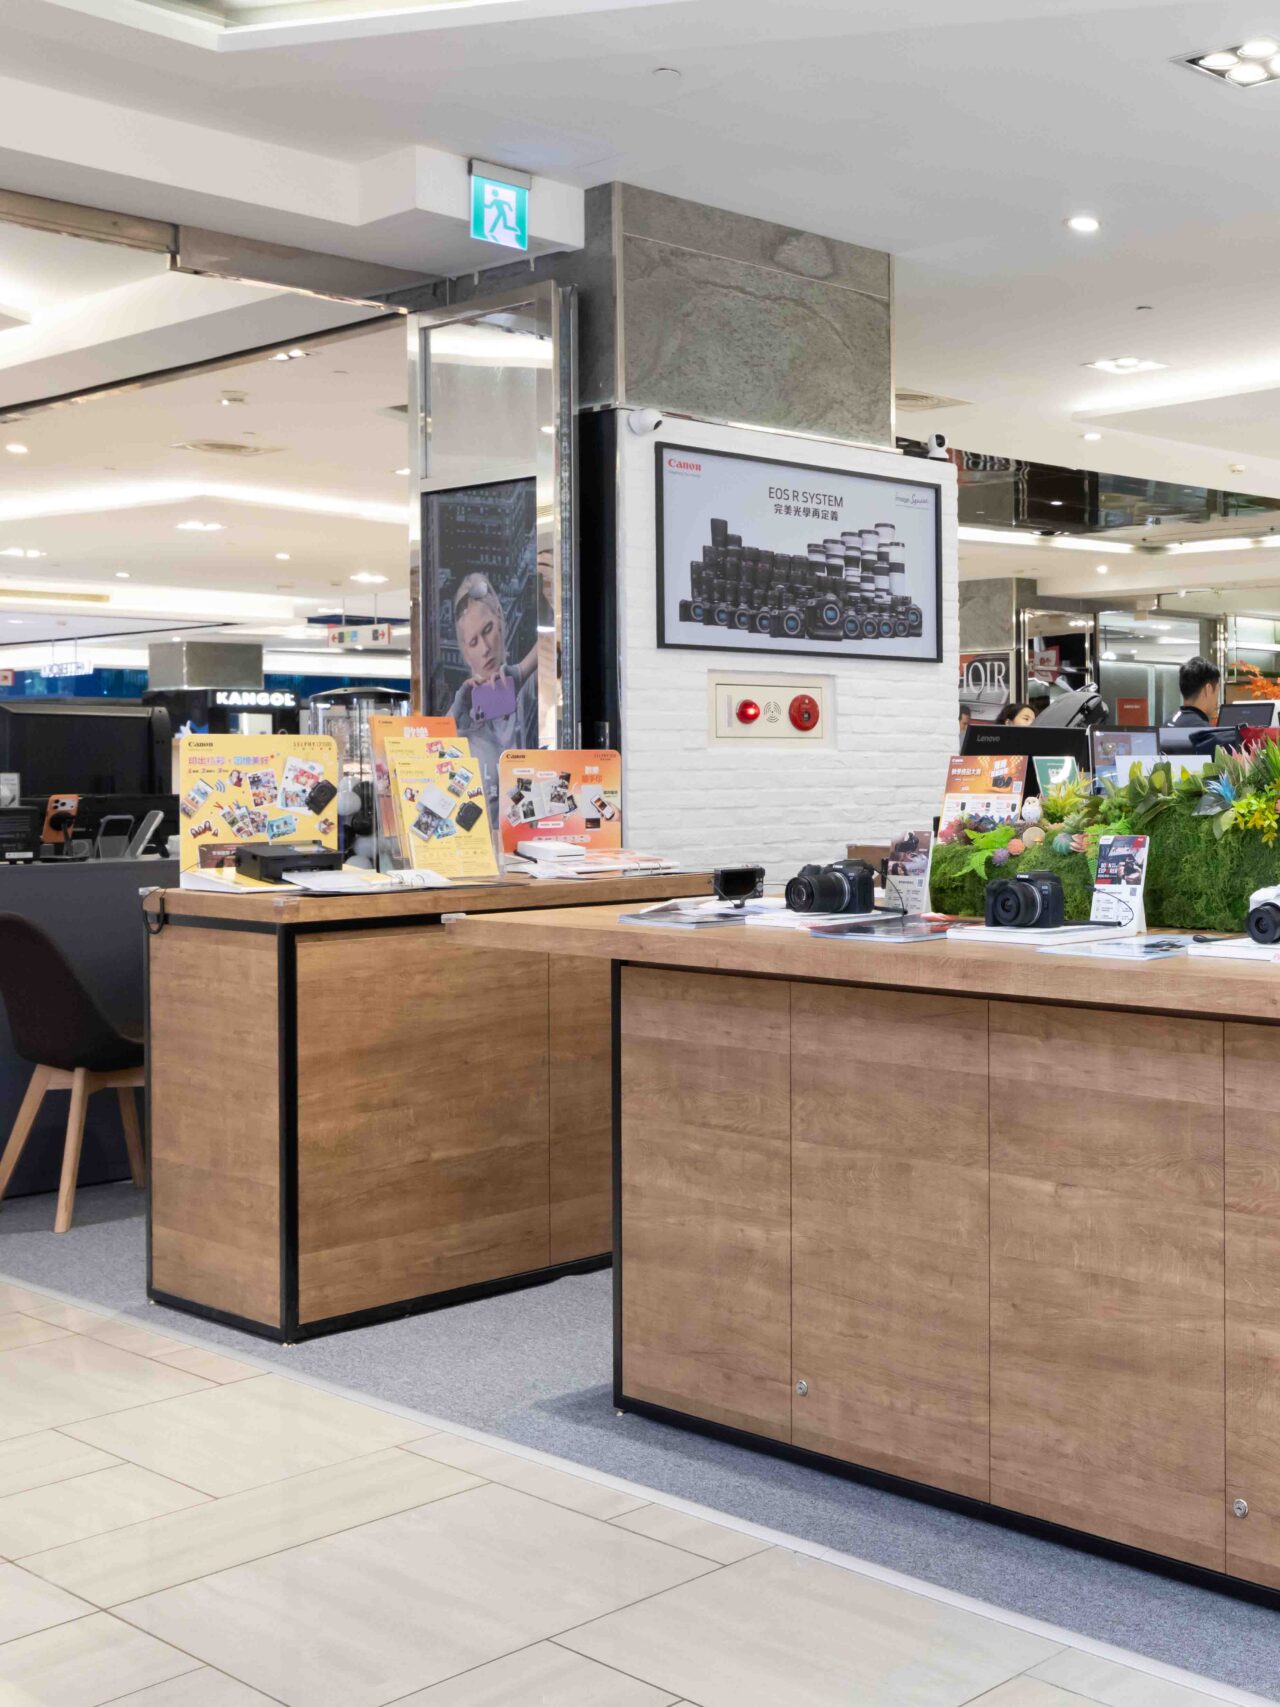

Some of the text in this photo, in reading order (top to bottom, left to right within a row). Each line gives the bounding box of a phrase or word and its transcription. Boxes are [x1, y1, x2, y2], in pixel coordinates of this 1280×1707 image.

[668, 458, 701, 471] Canon
[768, 486, 844, 509] EOS R SYSTEM
[773, 503, 839, 522] 完美光學再定義
[216, 691, 296, 706] KANGOL
[976, 734, 1001, 742] Lenovo
